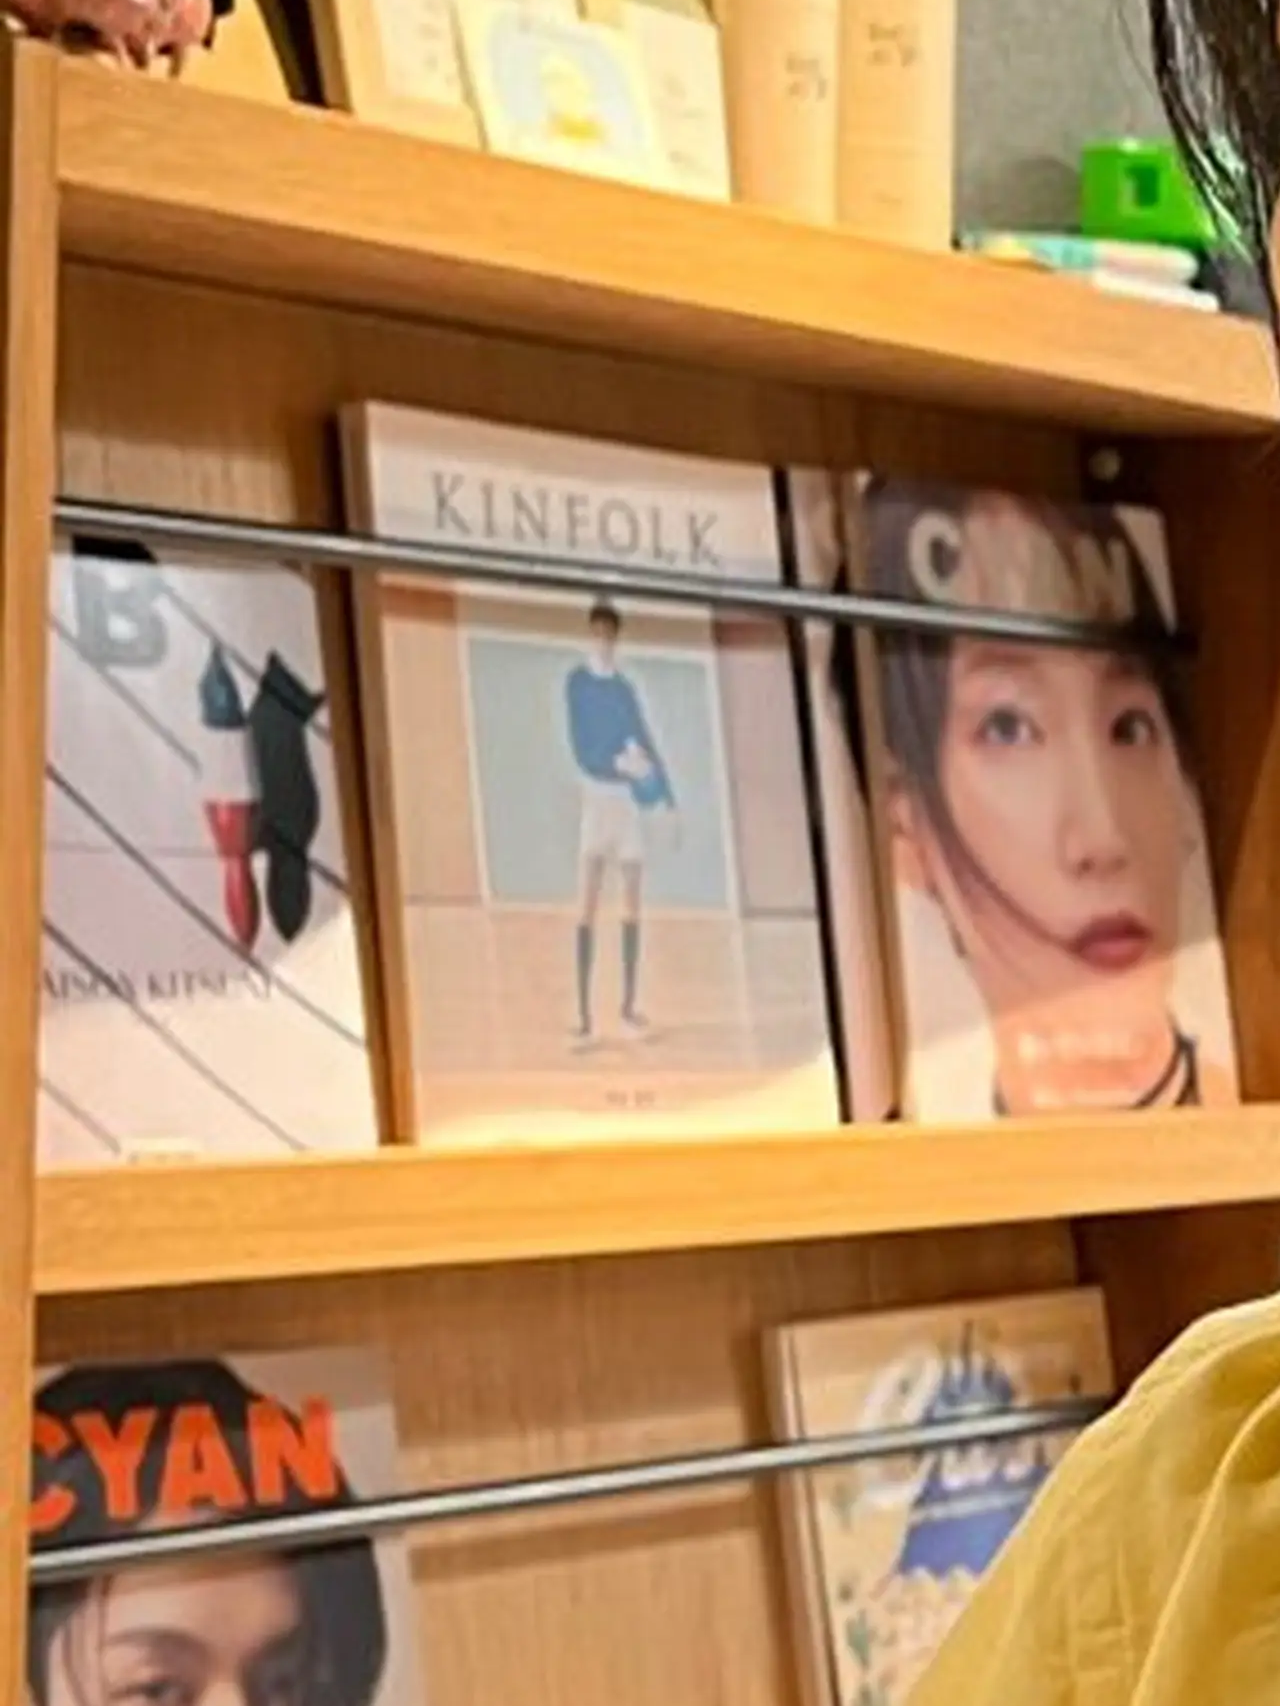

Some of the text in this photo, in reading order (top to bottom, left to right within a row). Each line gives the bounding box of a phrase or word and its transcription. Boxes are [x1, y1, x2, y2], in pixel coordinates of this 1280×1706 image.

[430, 470, 719, 566] KINFOLK
[74, 560, 169, 667] B
[30, 1396, 336, 1533] CYAN
